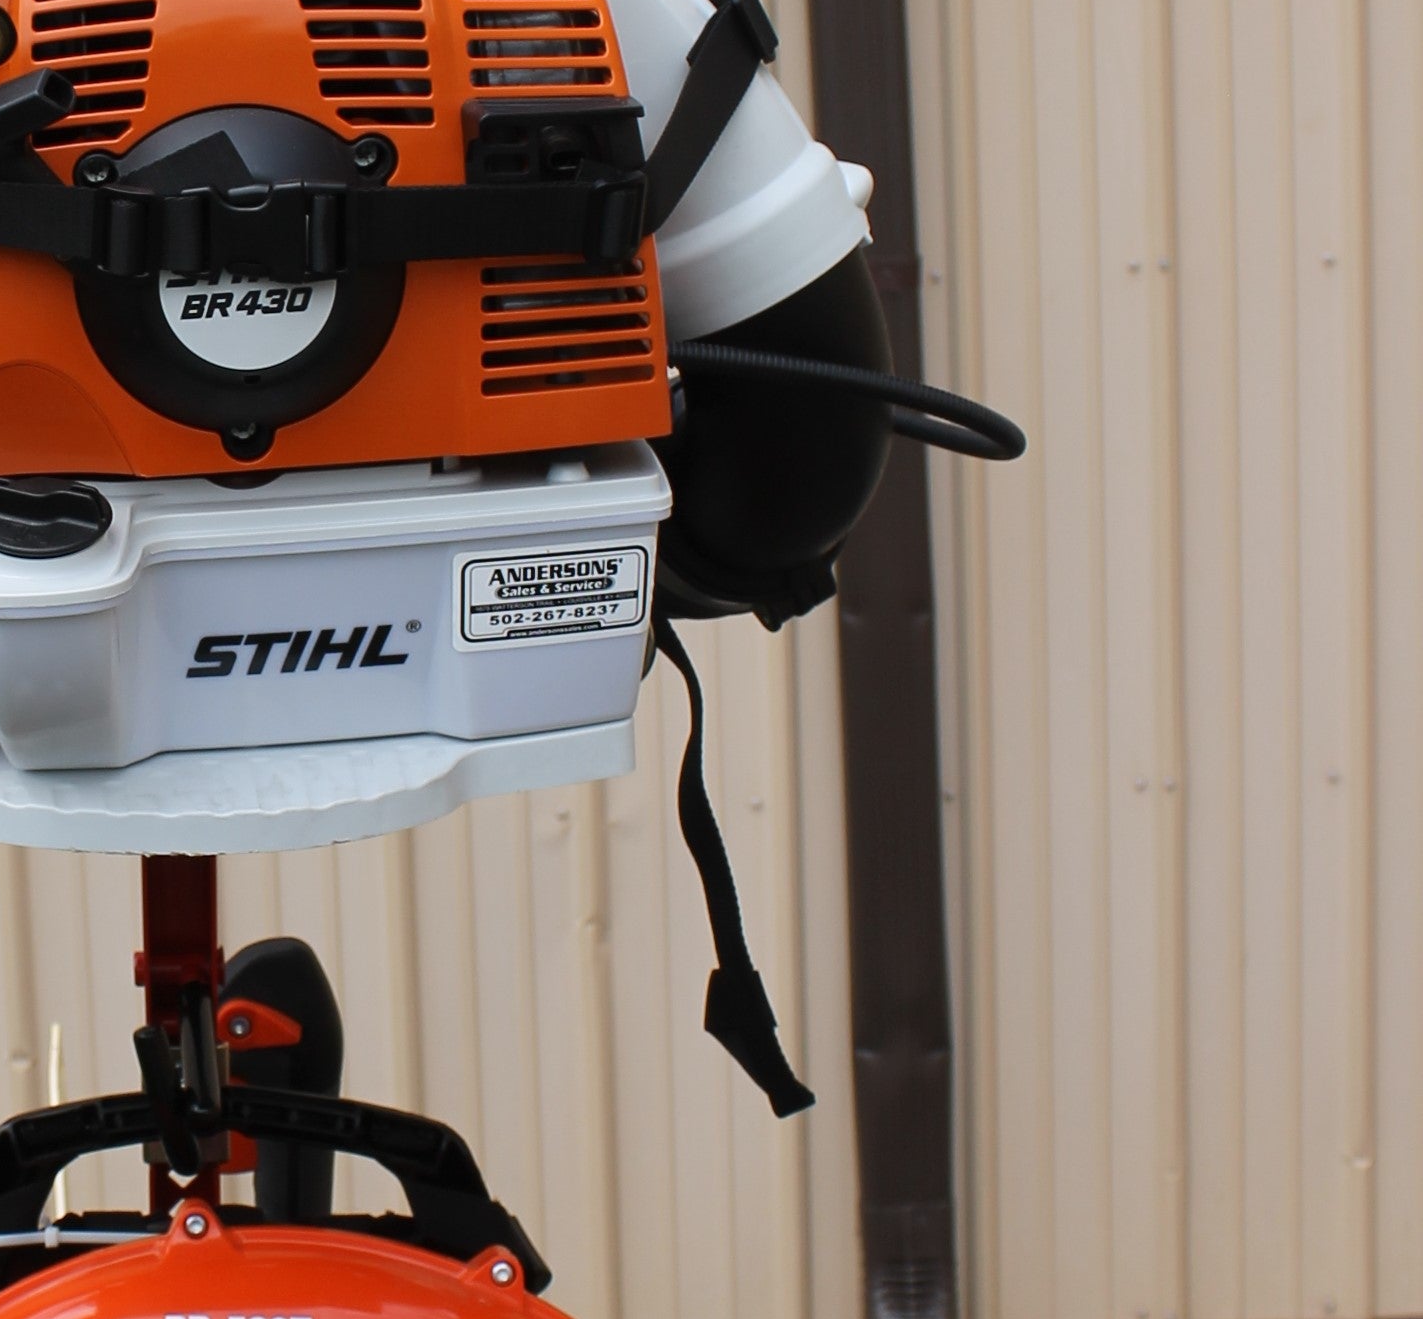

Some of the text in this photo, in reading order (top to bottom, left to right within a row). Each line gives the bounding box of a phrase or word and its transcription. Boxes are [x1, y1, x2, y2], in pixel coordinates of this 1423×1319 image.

[180, 286, 314, 320] BR 430
[488, 557, 623, 587] ANDERSONS'
[501, 585, 536, 598] Sales
[540, 584, 550, 594] &
[554, 580, 603, 593] Service
[490, 604, 619, 626] 502-267-8237
[186, 624, 409, 678] STIHL
